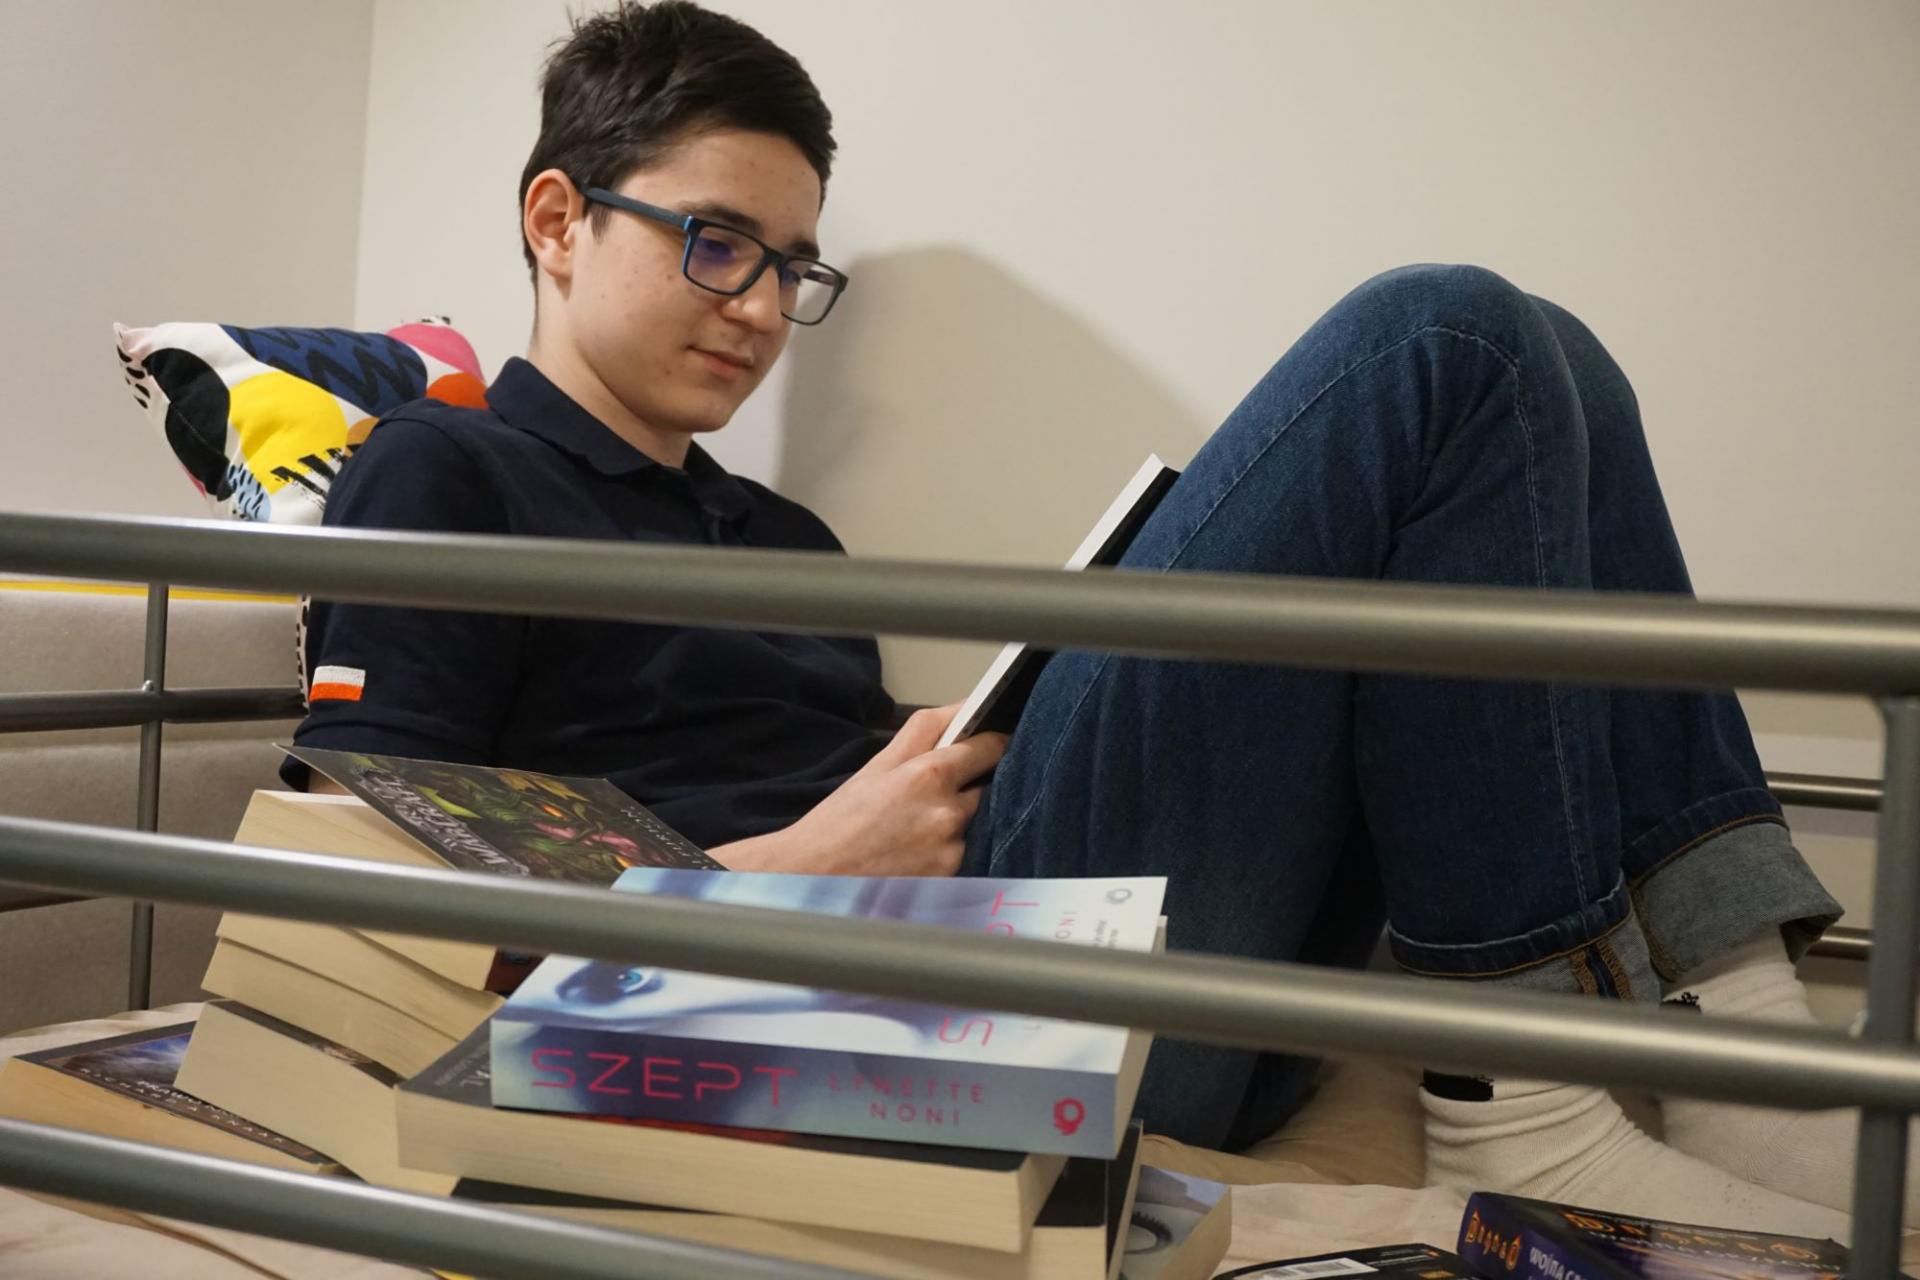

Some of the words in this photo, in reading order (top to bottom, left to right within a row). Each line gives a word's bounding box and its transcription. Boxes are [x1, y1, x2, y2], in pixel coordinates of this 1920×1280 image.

[530, 1047, 799, 1109] SZEPT
[827, 1071, 985, 1104] LYNETTE
[868, 1101, 961, 1126] NONI
